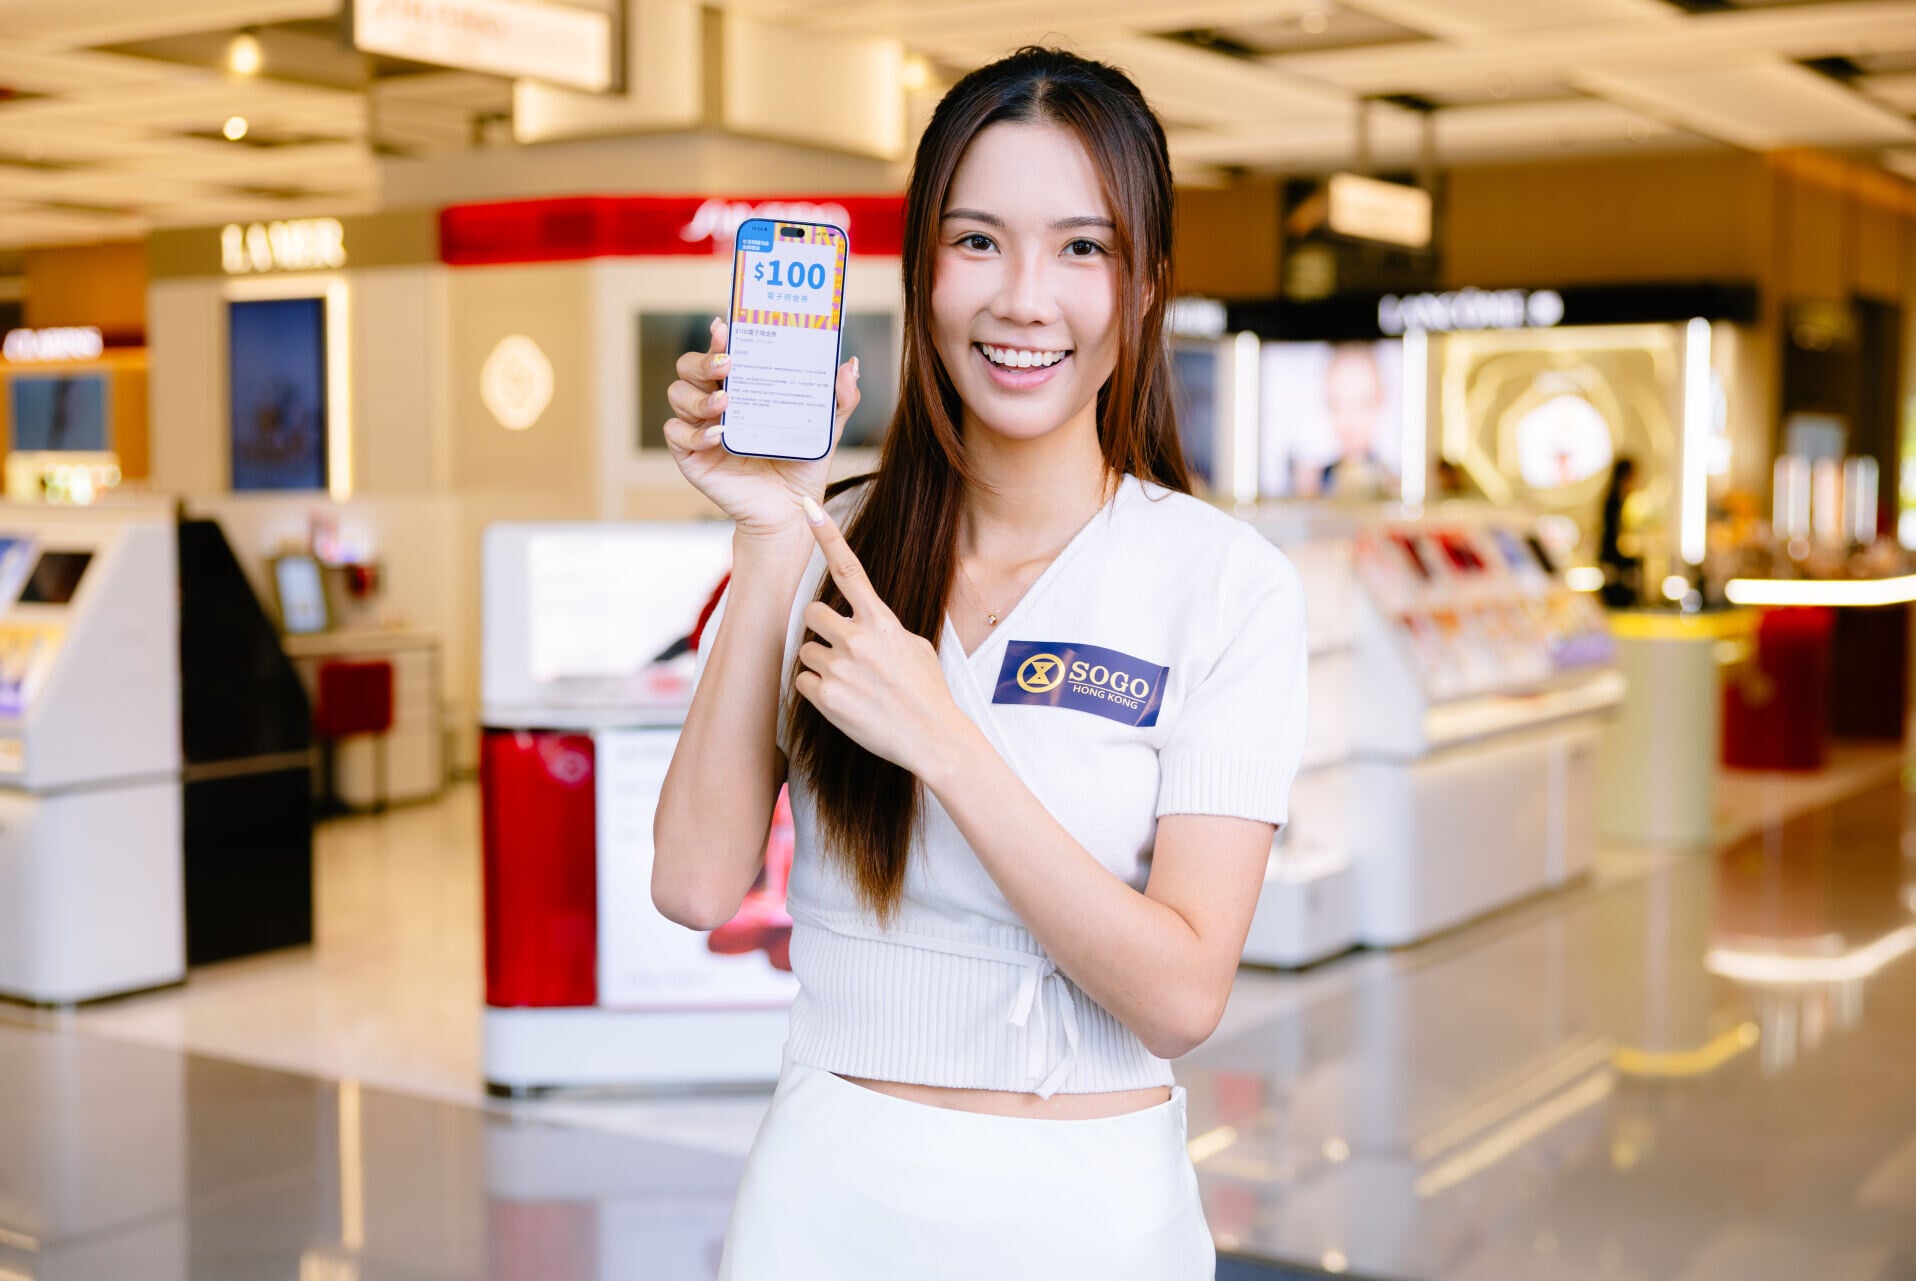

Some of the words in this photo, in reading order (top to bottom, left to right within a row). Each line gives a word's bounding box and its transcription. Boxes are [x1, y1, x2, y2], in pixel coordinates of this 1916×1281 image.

[754, 260, 825, 290] $100
[1068, 661, 1149, 699] SOGO
[1072, 684, 1105, 699] HONG
[1107, 692, 1139, 710] KONG
